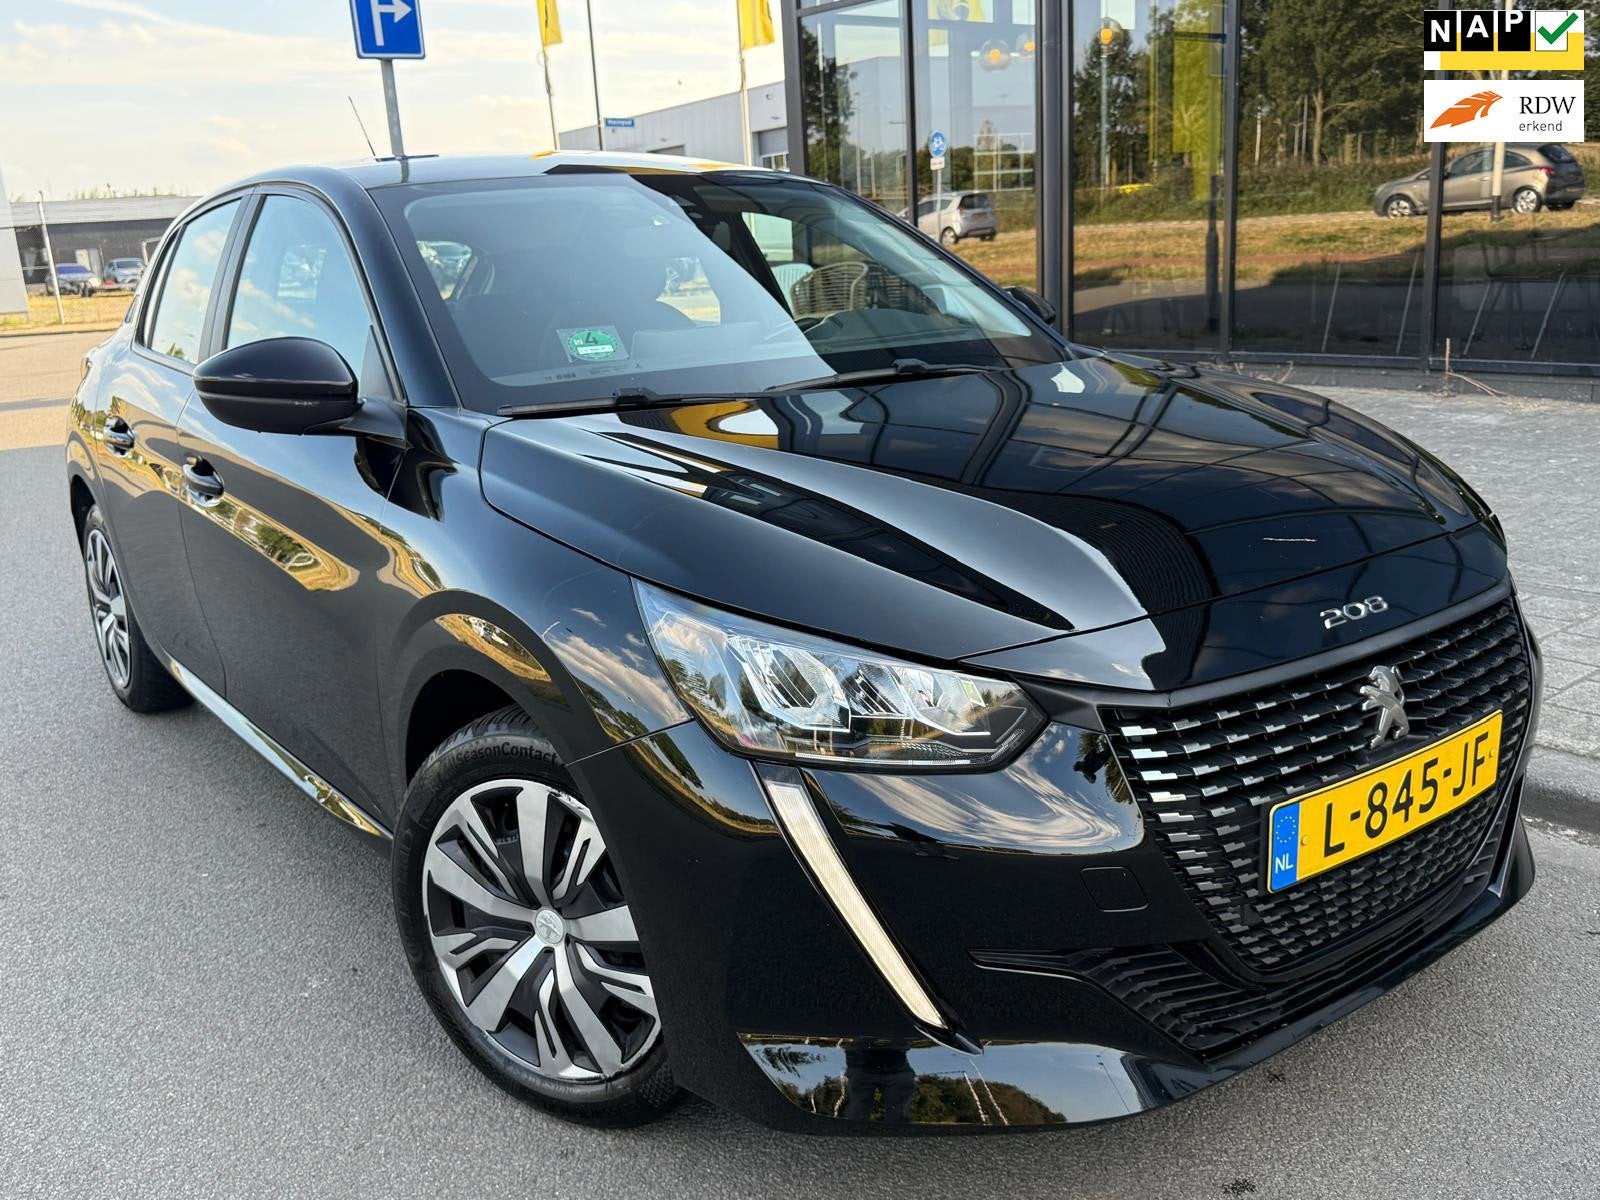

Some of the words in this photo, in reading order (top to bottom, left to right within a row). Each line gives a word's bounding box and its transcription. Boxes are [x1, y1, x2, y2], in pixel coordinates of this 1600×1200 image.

[585, 331, 599, 345] 4
[1320, 595, 1388, 630] 208
[1323, 731, 1489, 858] L-845-JF
[1275, 854, 1294, 874] NL
